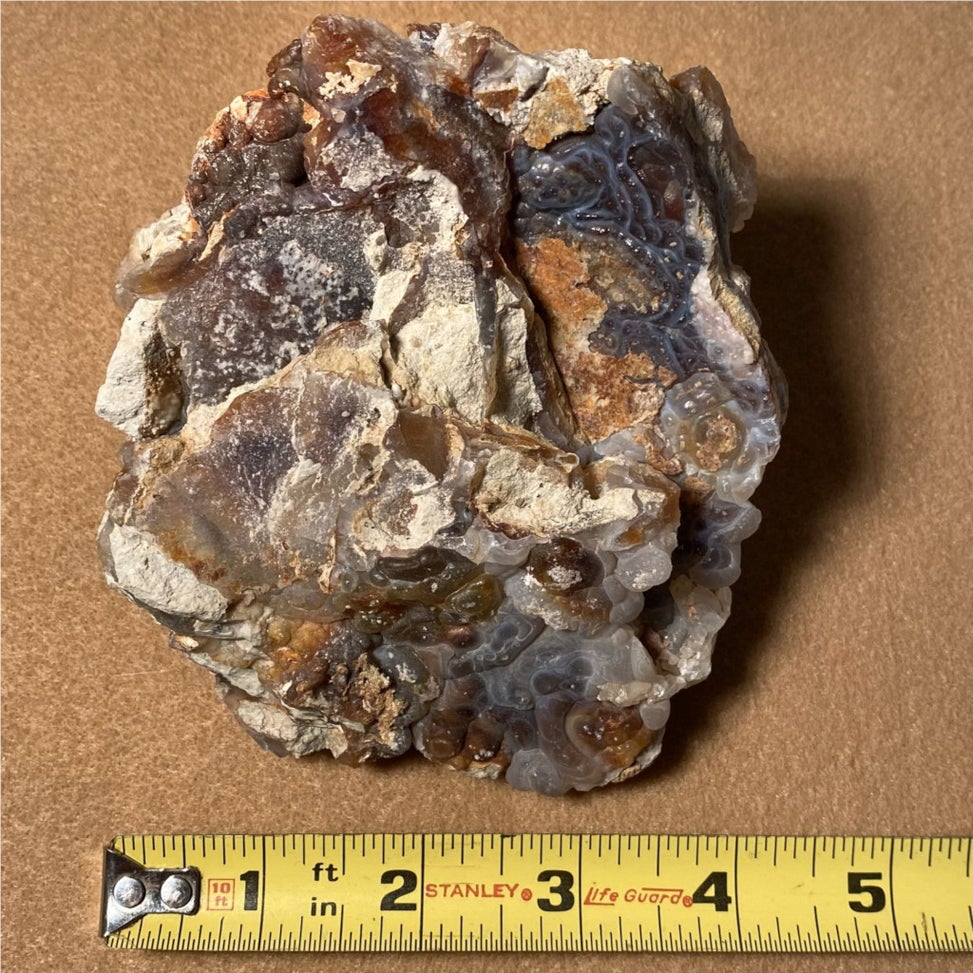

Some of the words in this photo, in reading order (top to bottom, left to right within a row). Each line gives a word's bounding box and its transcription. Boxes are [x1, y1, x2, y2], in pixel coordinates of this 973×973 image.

[212, 882, 230, 893] 10
[240, 870, 259, 911] 1
[313, 863, 338, 882] ft
[380, 870, 418, 911] 2
[537, 870, 575, 911] 3
[692, 872, 731, 912] 4
[847, 872, 886, 912] 5
[215, 896, 228, 906] ft
[311, 898, 336, 916] in
